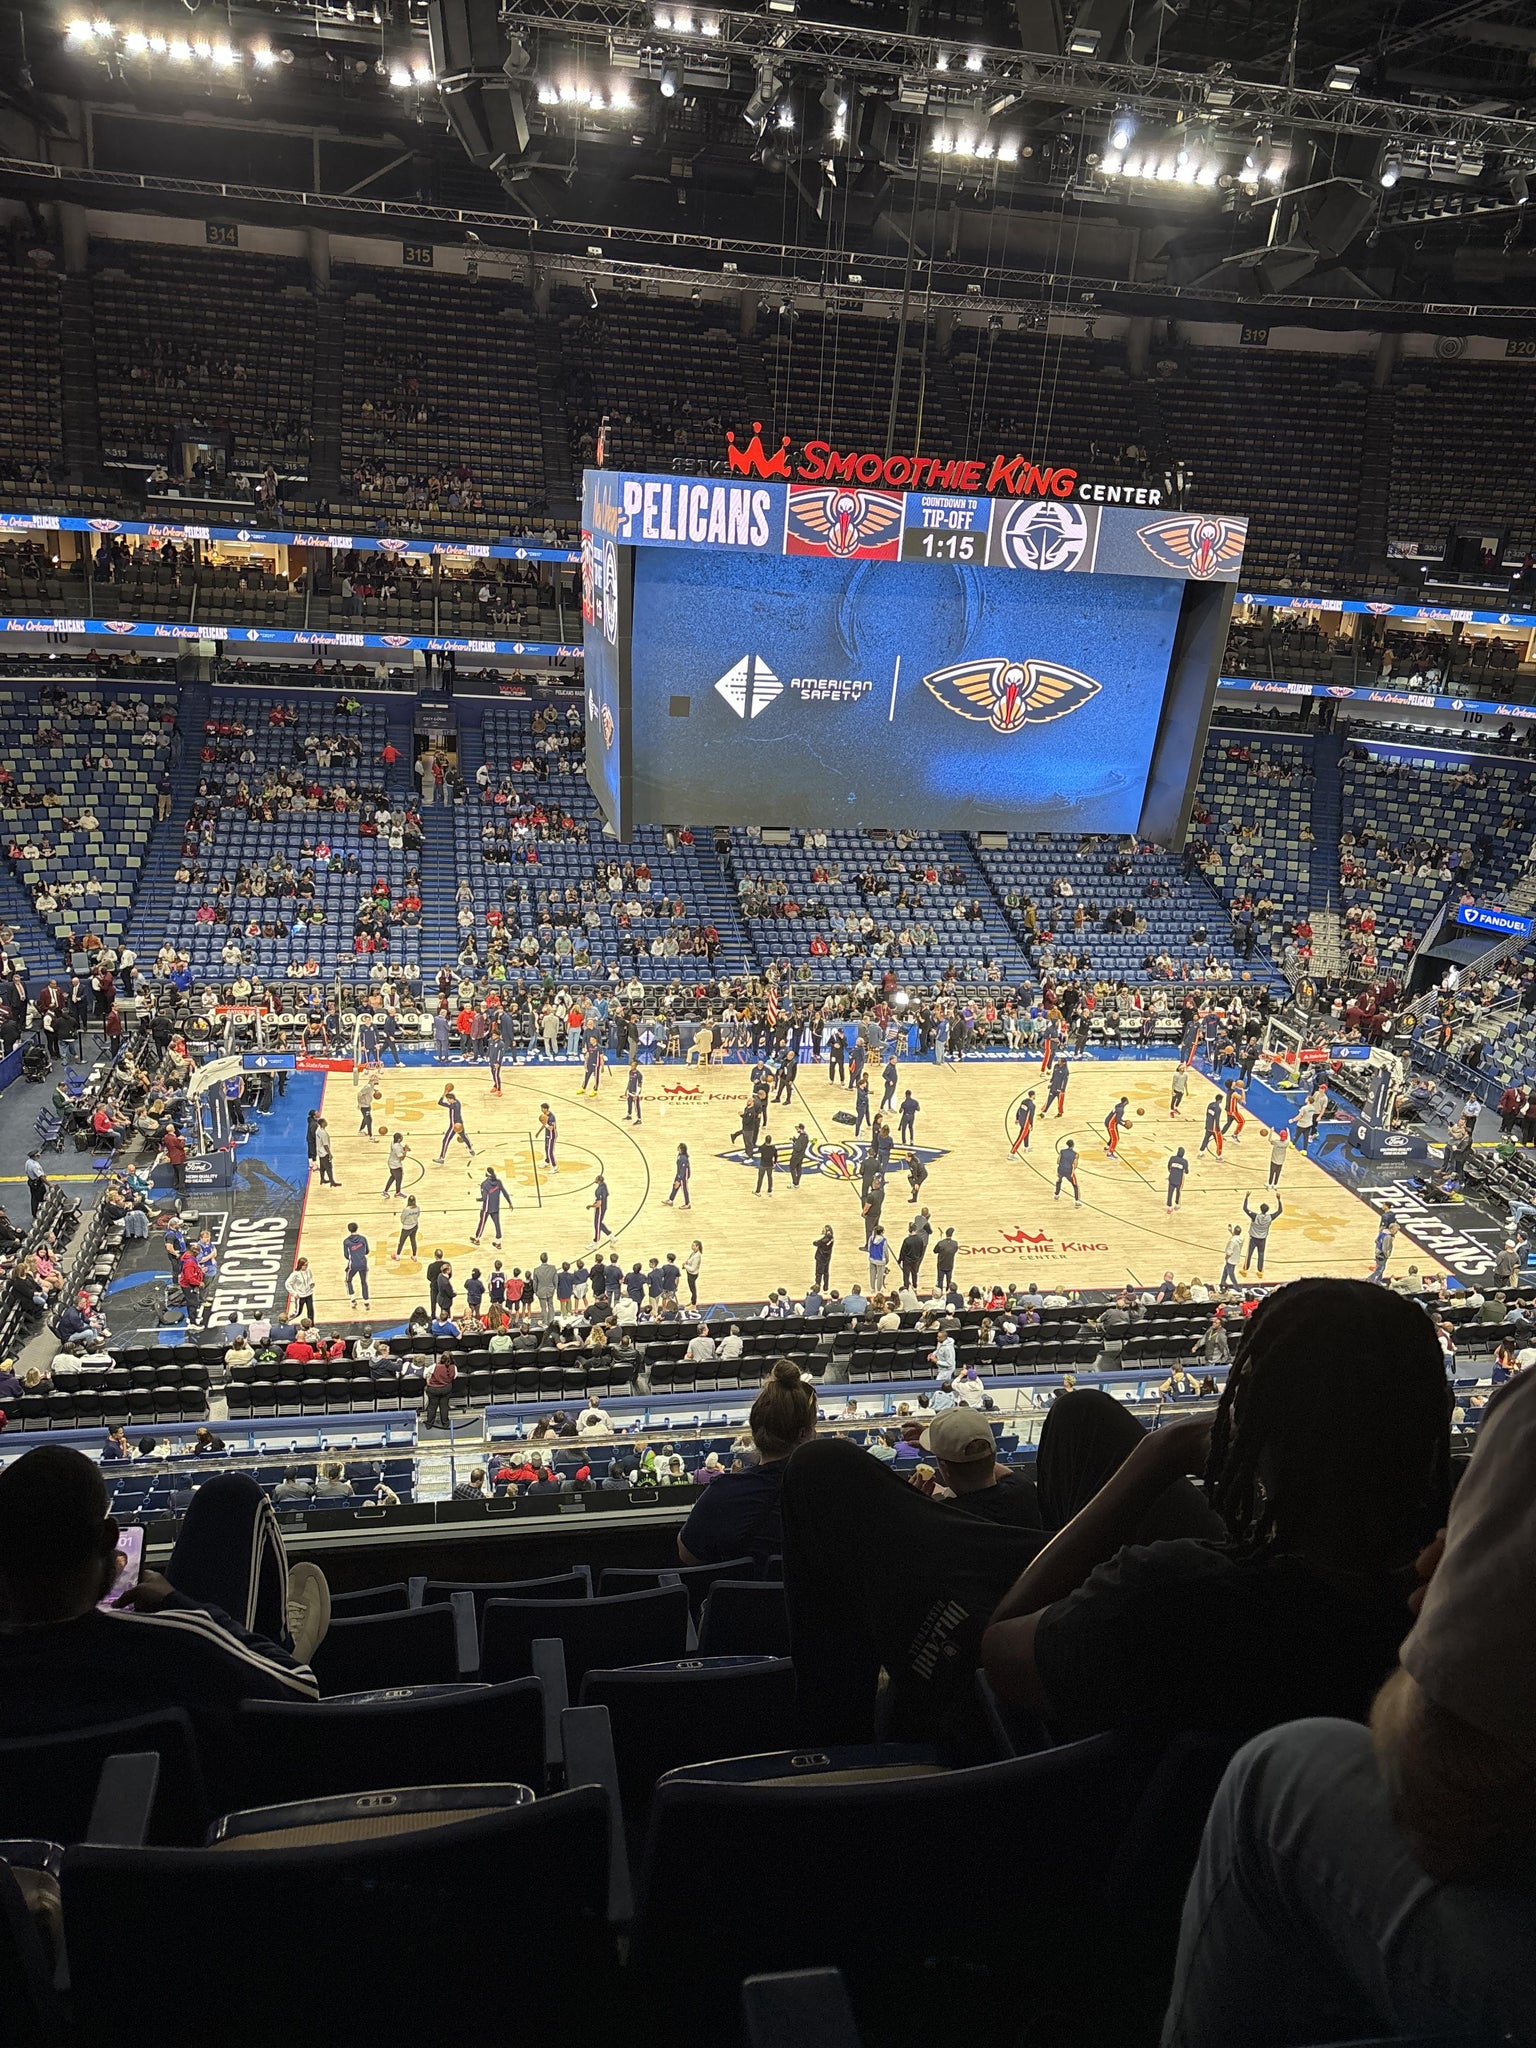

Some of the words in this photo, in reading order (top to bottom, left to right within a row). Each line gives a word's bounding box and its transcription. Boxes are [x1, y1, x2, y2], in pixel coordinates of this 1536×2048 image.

[209, 226, 235, 243] 314
[405, 247, 431, 263] 315
[1243, 328, 1267, 342] 319
[1508, 341, 1536, 356] 320
[798, 440, 986, 491] SMOOTHIE
[922, 496, 968, 509] COUNTDOWN
[970, 501, 978, 509] TO
[1079, 483, 1162, 506] CENTER
[622, 480, 771, 547] PELICANS
[922, 508, 974, 530] TIP-OFF
[33, 515, 60, 530] PELICANS
[922, 533, 975, 561] 1:15
[790, 678, 873, 691] AMERICAN
[801, 689, 861, 701] SAFETY
[1480, 914, 1527, 931] FANDUEL
[1357, 1125, 1367, 1141] G
[957, 1244, 1056, 1256] SMOOTHIE
[207, 1217, 289, 1329] PELICANS
